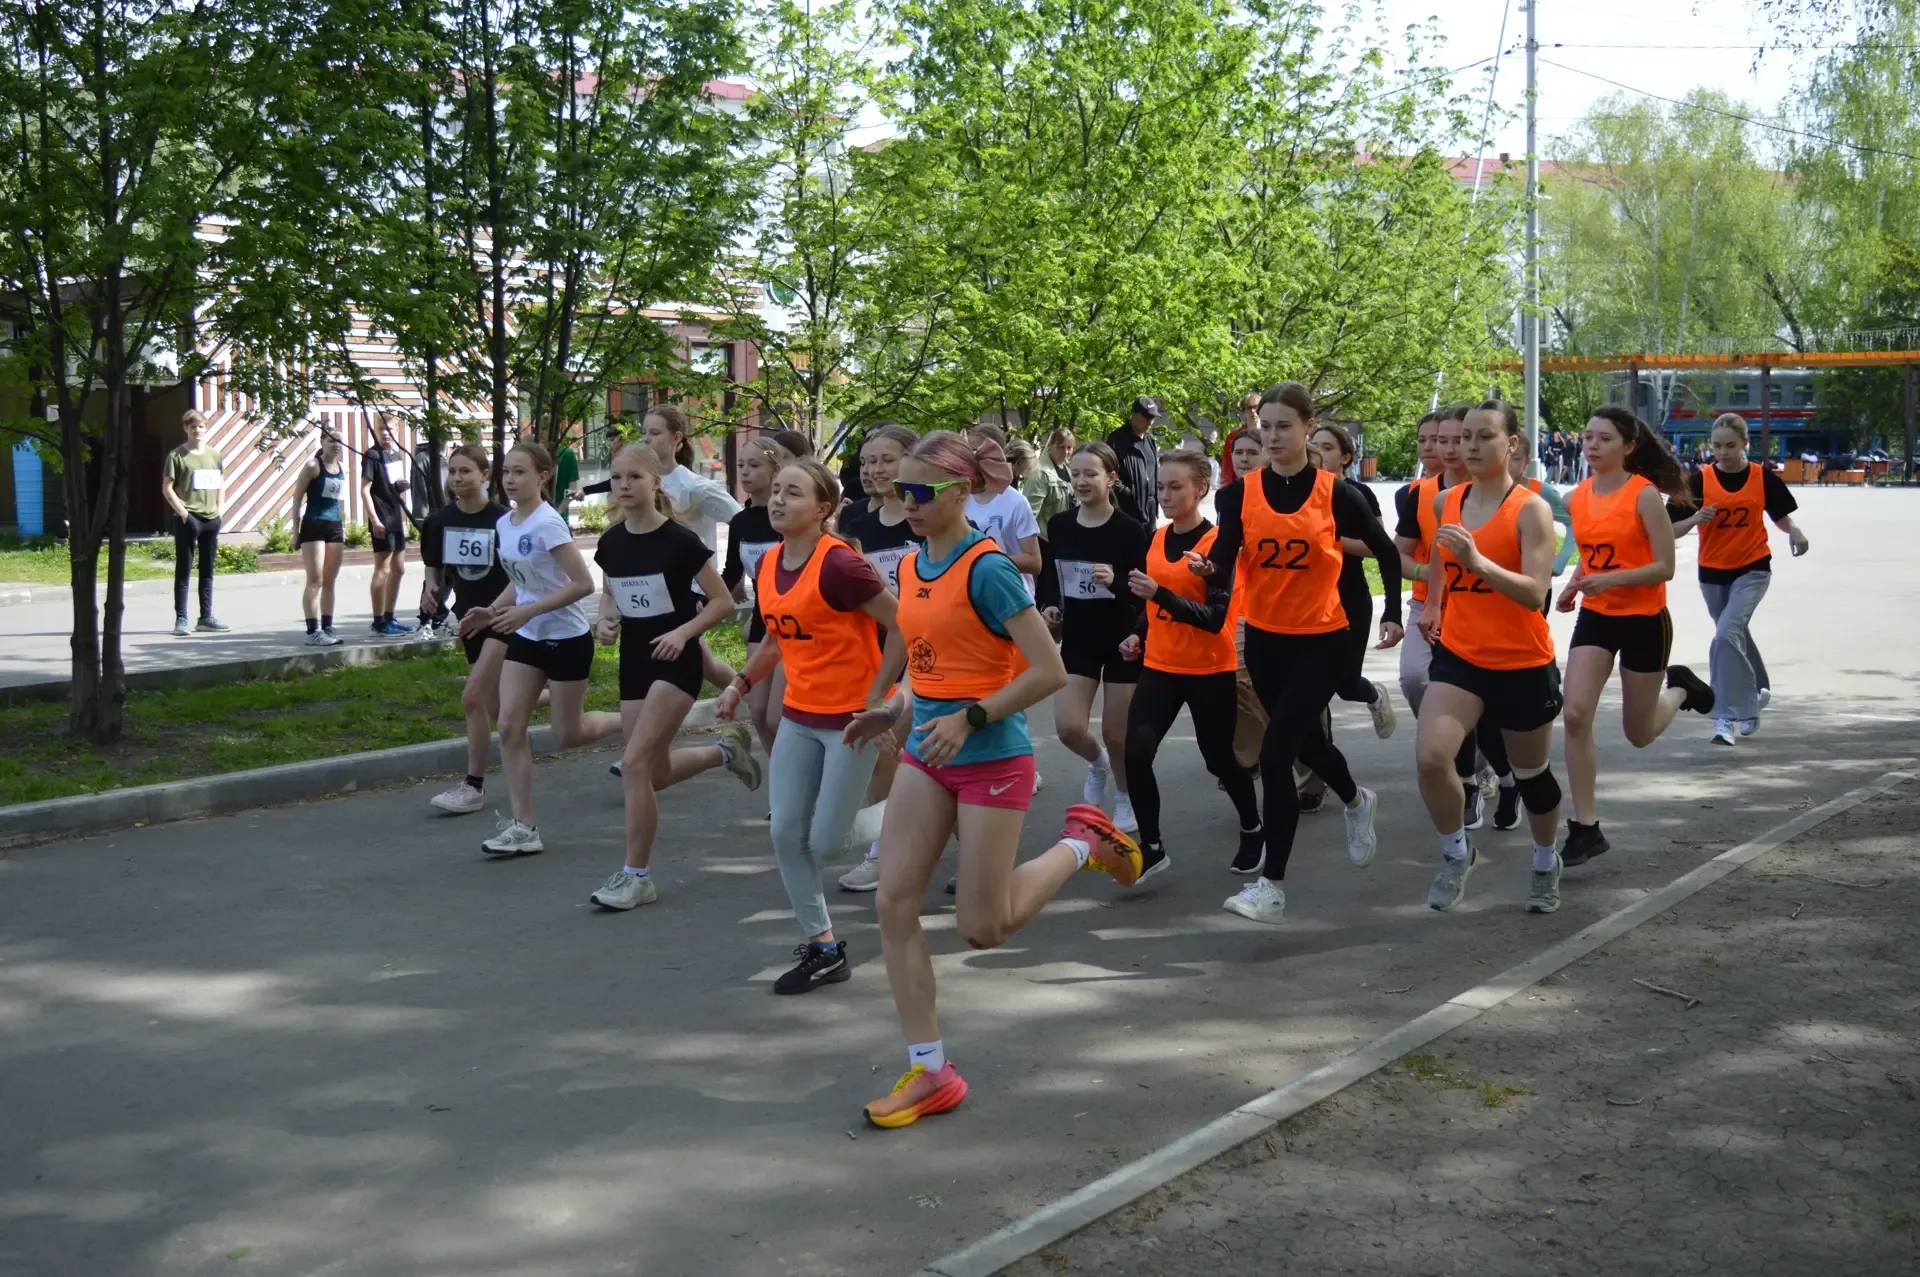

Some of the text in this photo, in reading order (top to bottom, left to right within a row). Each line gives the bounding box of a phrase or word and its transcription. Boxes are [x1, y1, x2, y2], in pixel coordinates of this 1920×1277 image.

[1716, 507, 1749, 528] 22
[459, 539, 482, 557] 56
[1258, 538, 1310, 569] 22
[1582, 543, 1620, 570] 22
[621, 580, 649, 588] ШКОЛА
[1079, 580, 1097, 594] 56
[631, 594, 650, 609] 56
